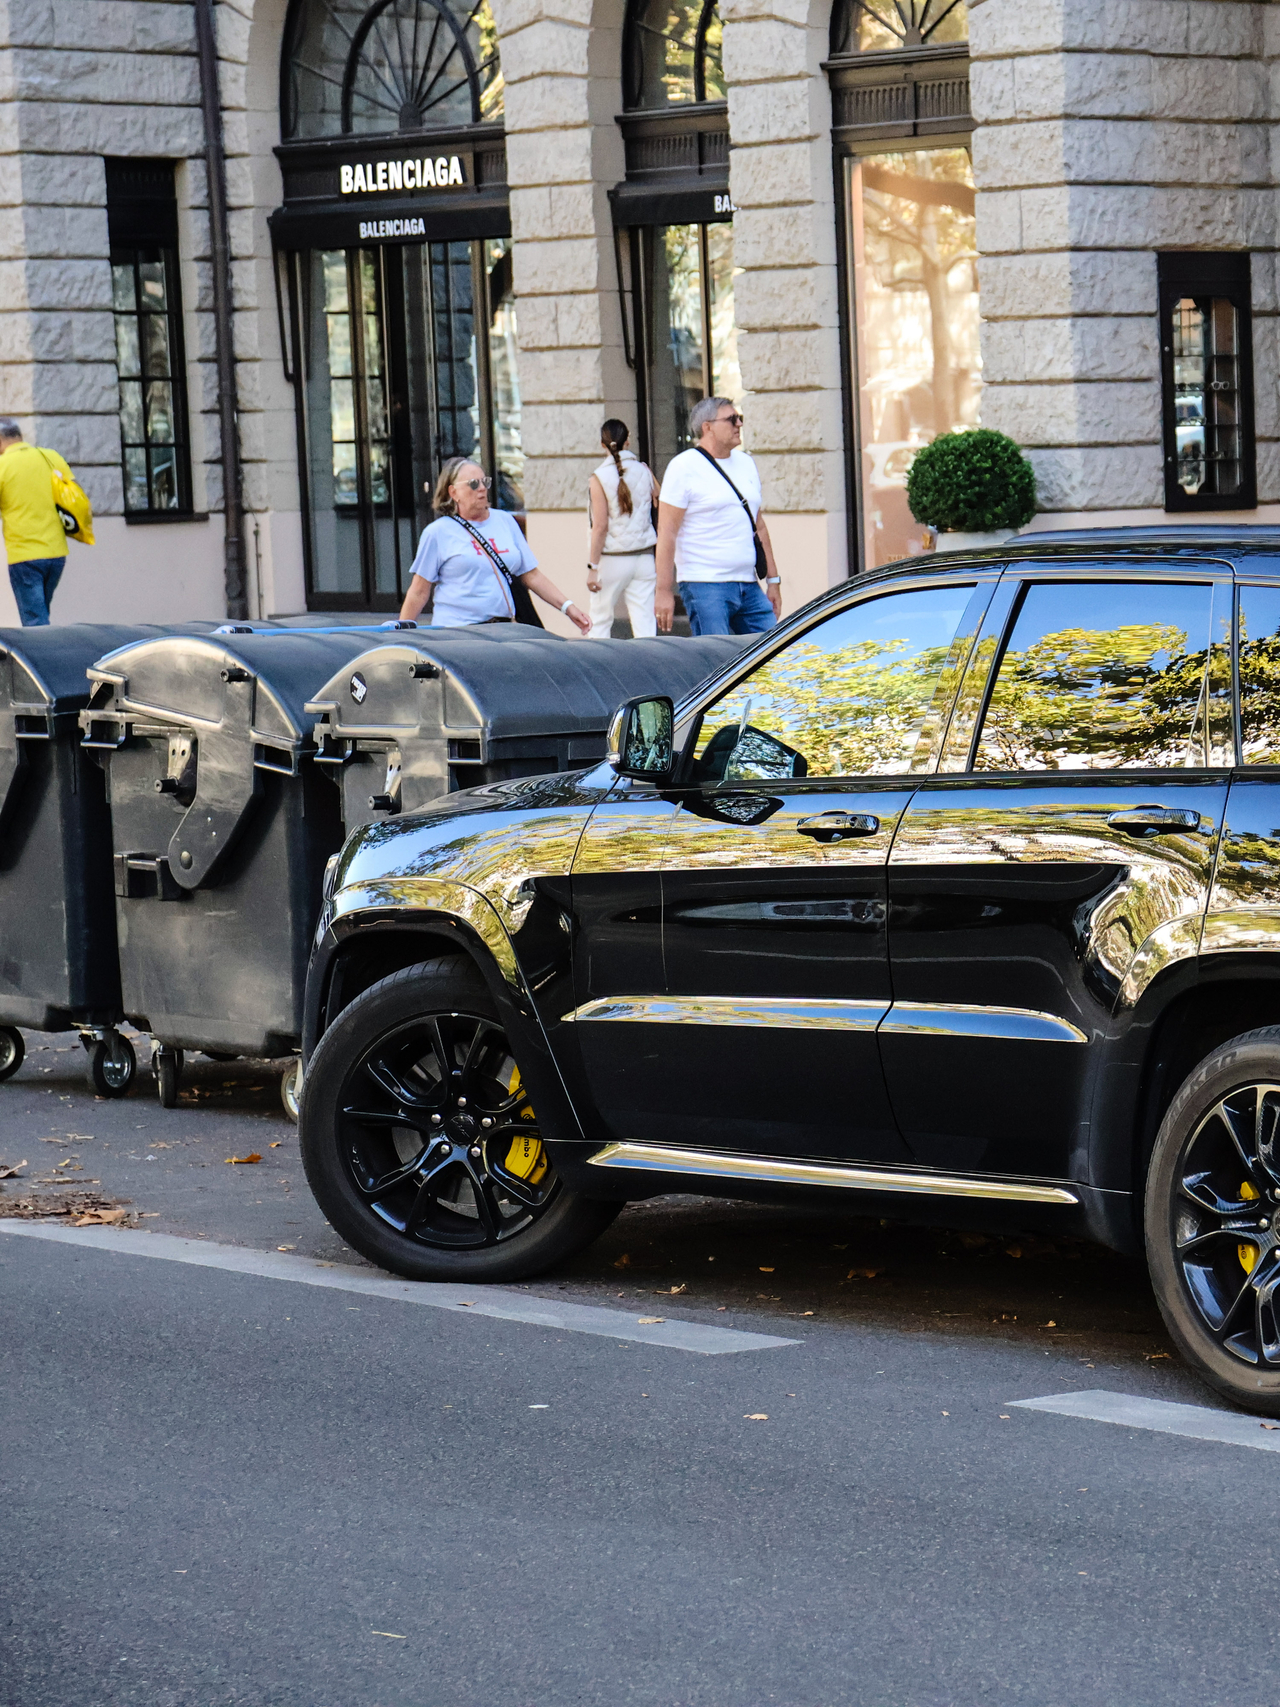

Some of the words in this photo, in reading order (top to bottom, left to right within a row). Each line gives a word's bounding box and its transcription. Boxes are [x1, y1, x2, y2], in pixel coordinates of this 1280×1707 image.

[340, 155, 464, 194] BALENCIAGA
[359, 217, 426, 240] BALENCIAGA
[484, 543, 505, 569] EXCHANGE
